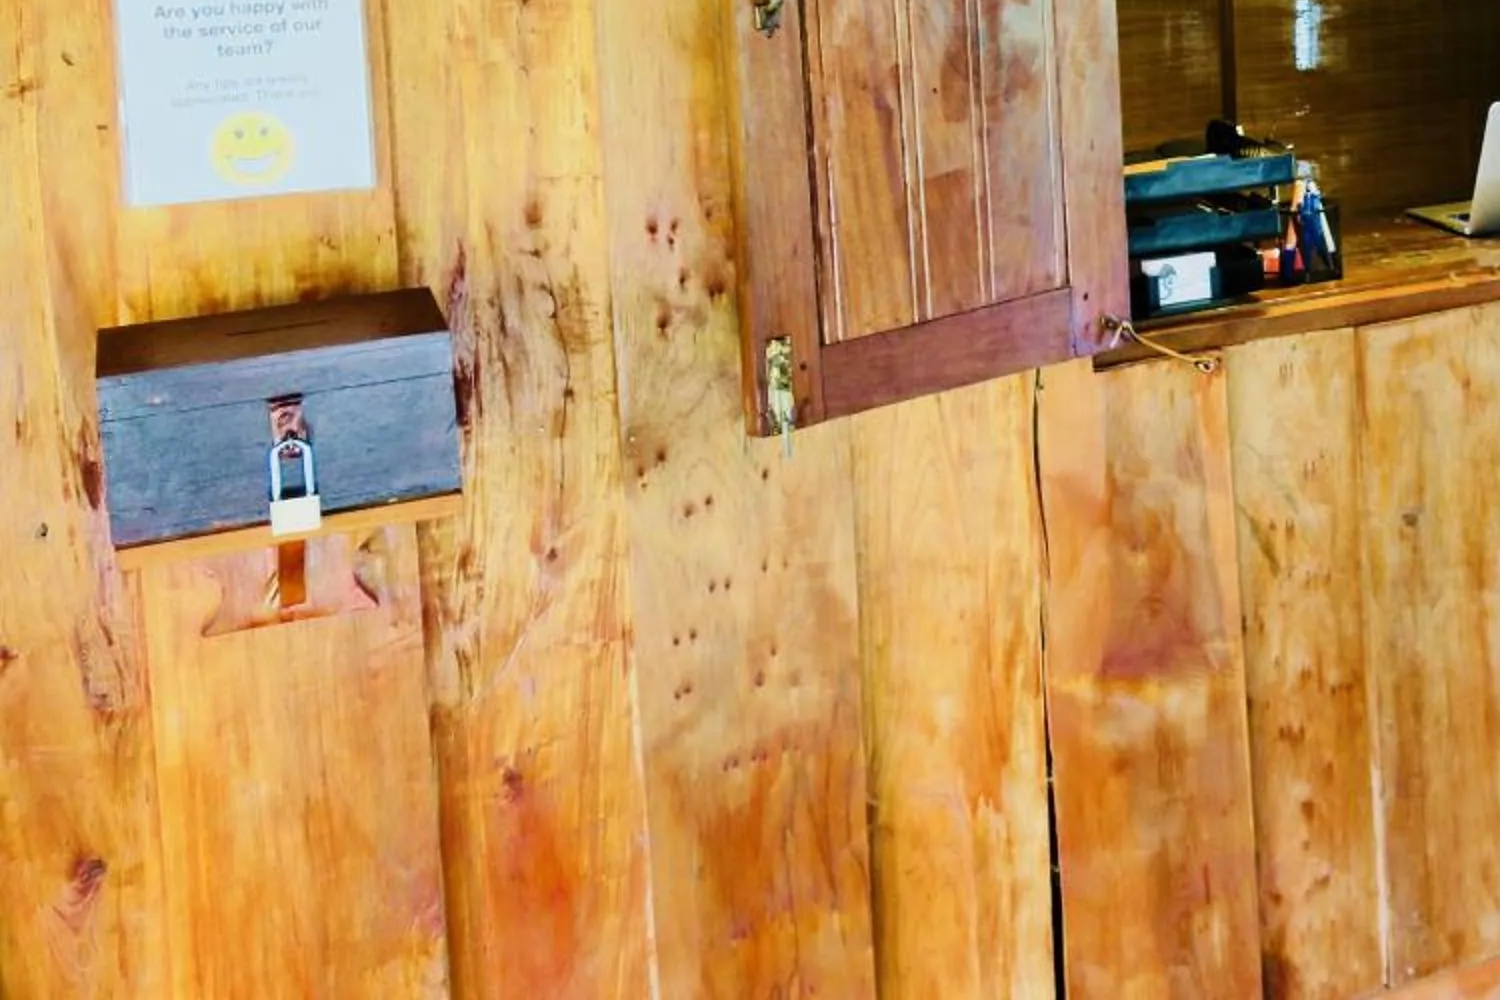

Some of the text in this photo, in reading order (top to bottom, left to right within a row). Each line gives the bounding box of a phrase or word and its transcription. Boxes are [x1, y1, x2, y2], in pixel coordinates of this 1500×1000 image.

[153, 4, 186, 20] Are
[191, 4, 225, 21] you
[228, 0, 286, 17] happy
[163, 17, 323, 40] the service of our
[216, 39, 274, 58] team?
